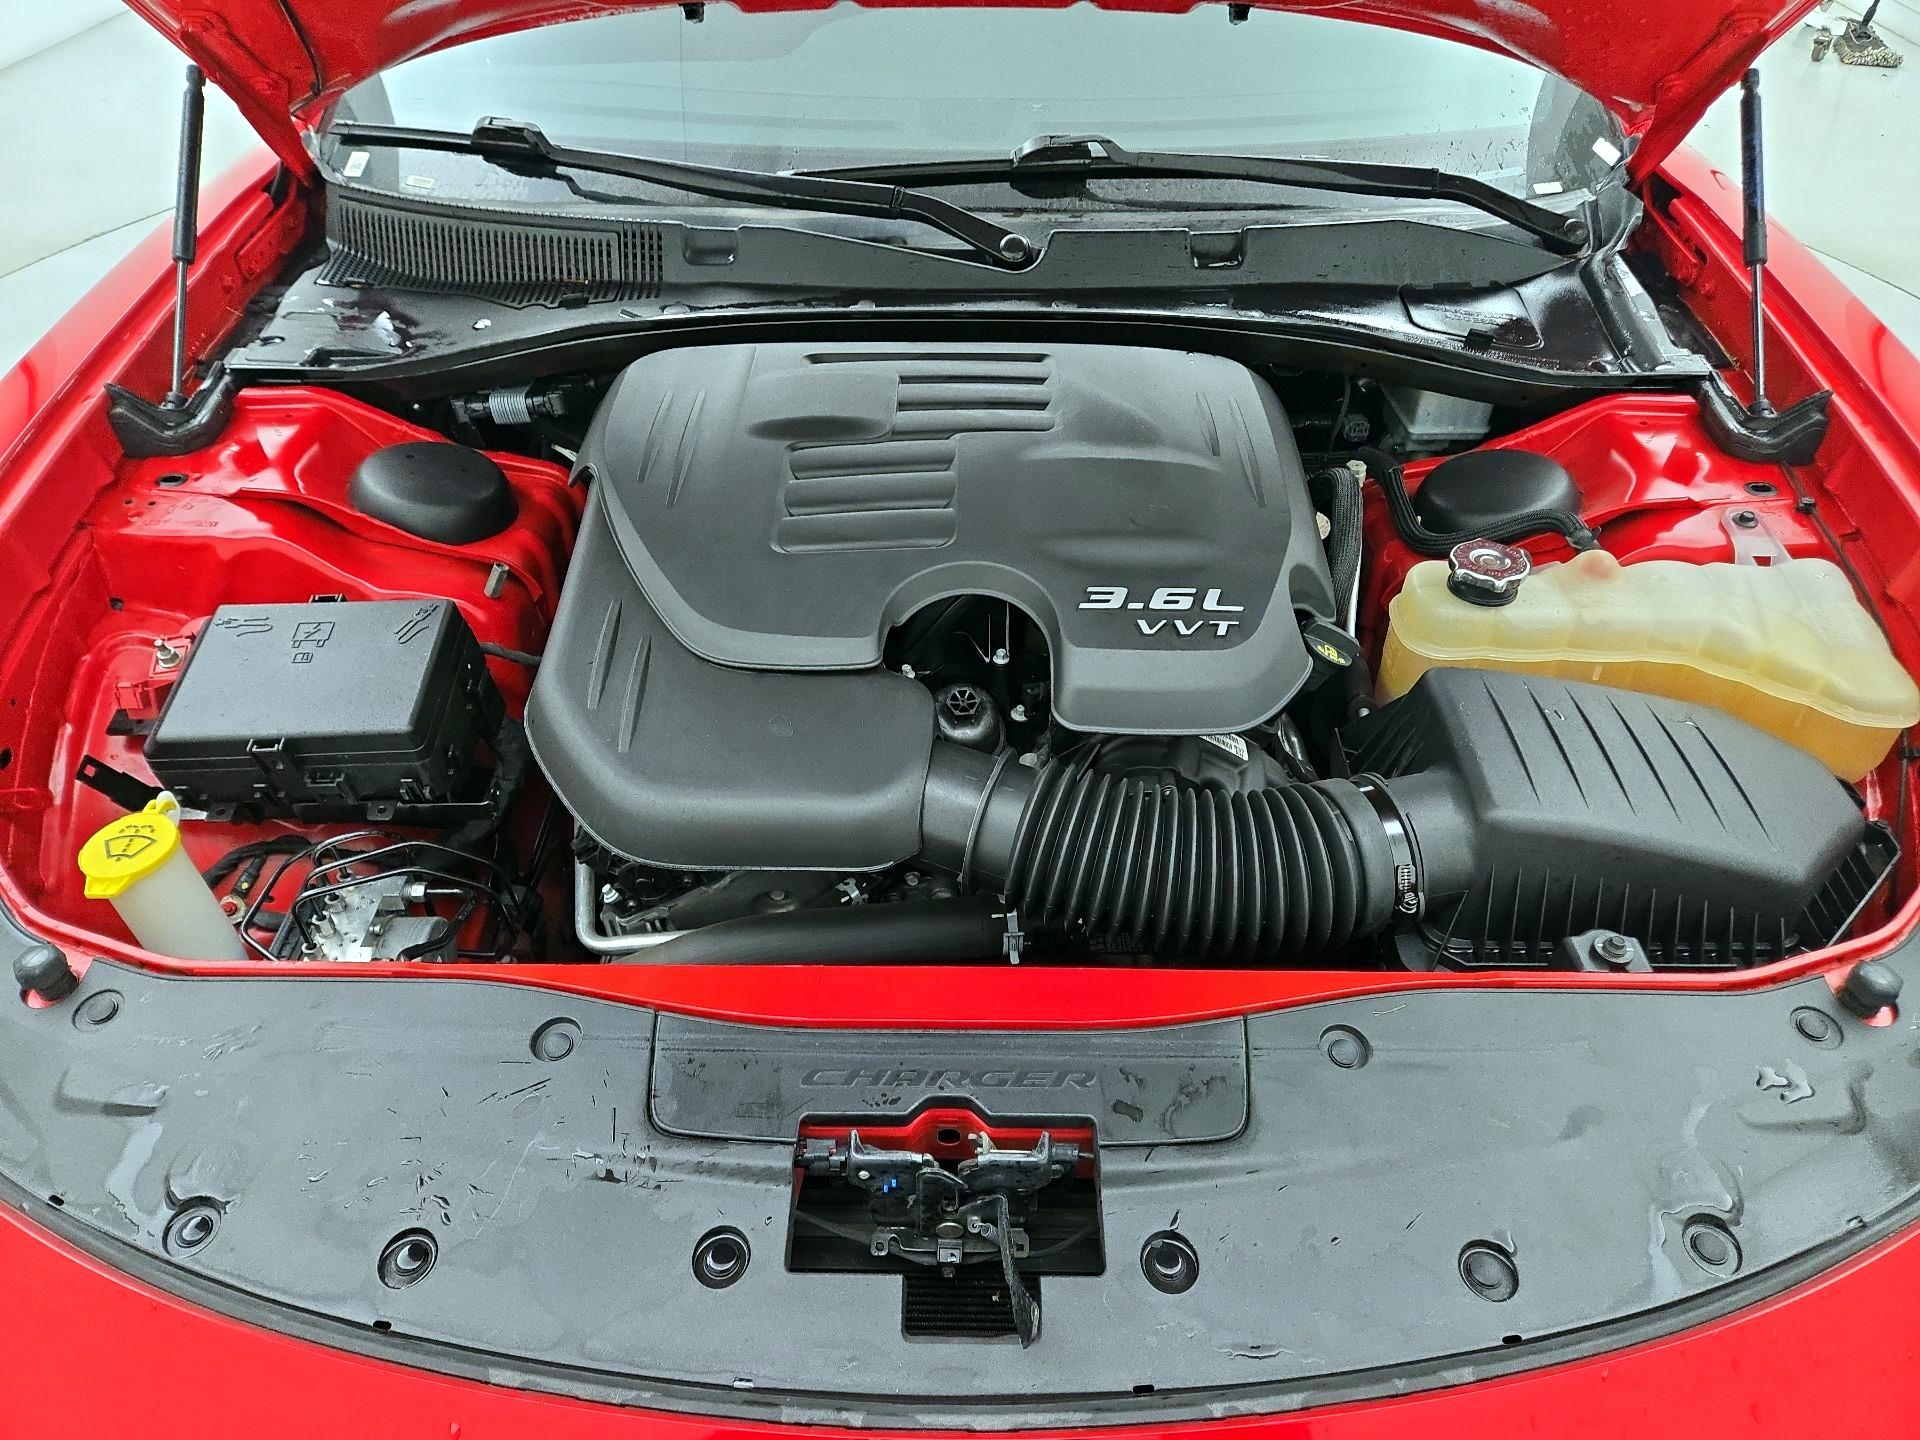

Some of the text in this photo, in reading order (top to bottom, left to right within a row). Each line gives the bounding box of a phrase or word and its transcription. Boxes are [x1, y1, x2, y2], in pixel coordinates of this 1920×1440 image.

[1078, 586, 1245, 612] 3.6L
[1136, 619, 1240, 636] VVT
[800, 1068, 1098, 1089] CHARGER
